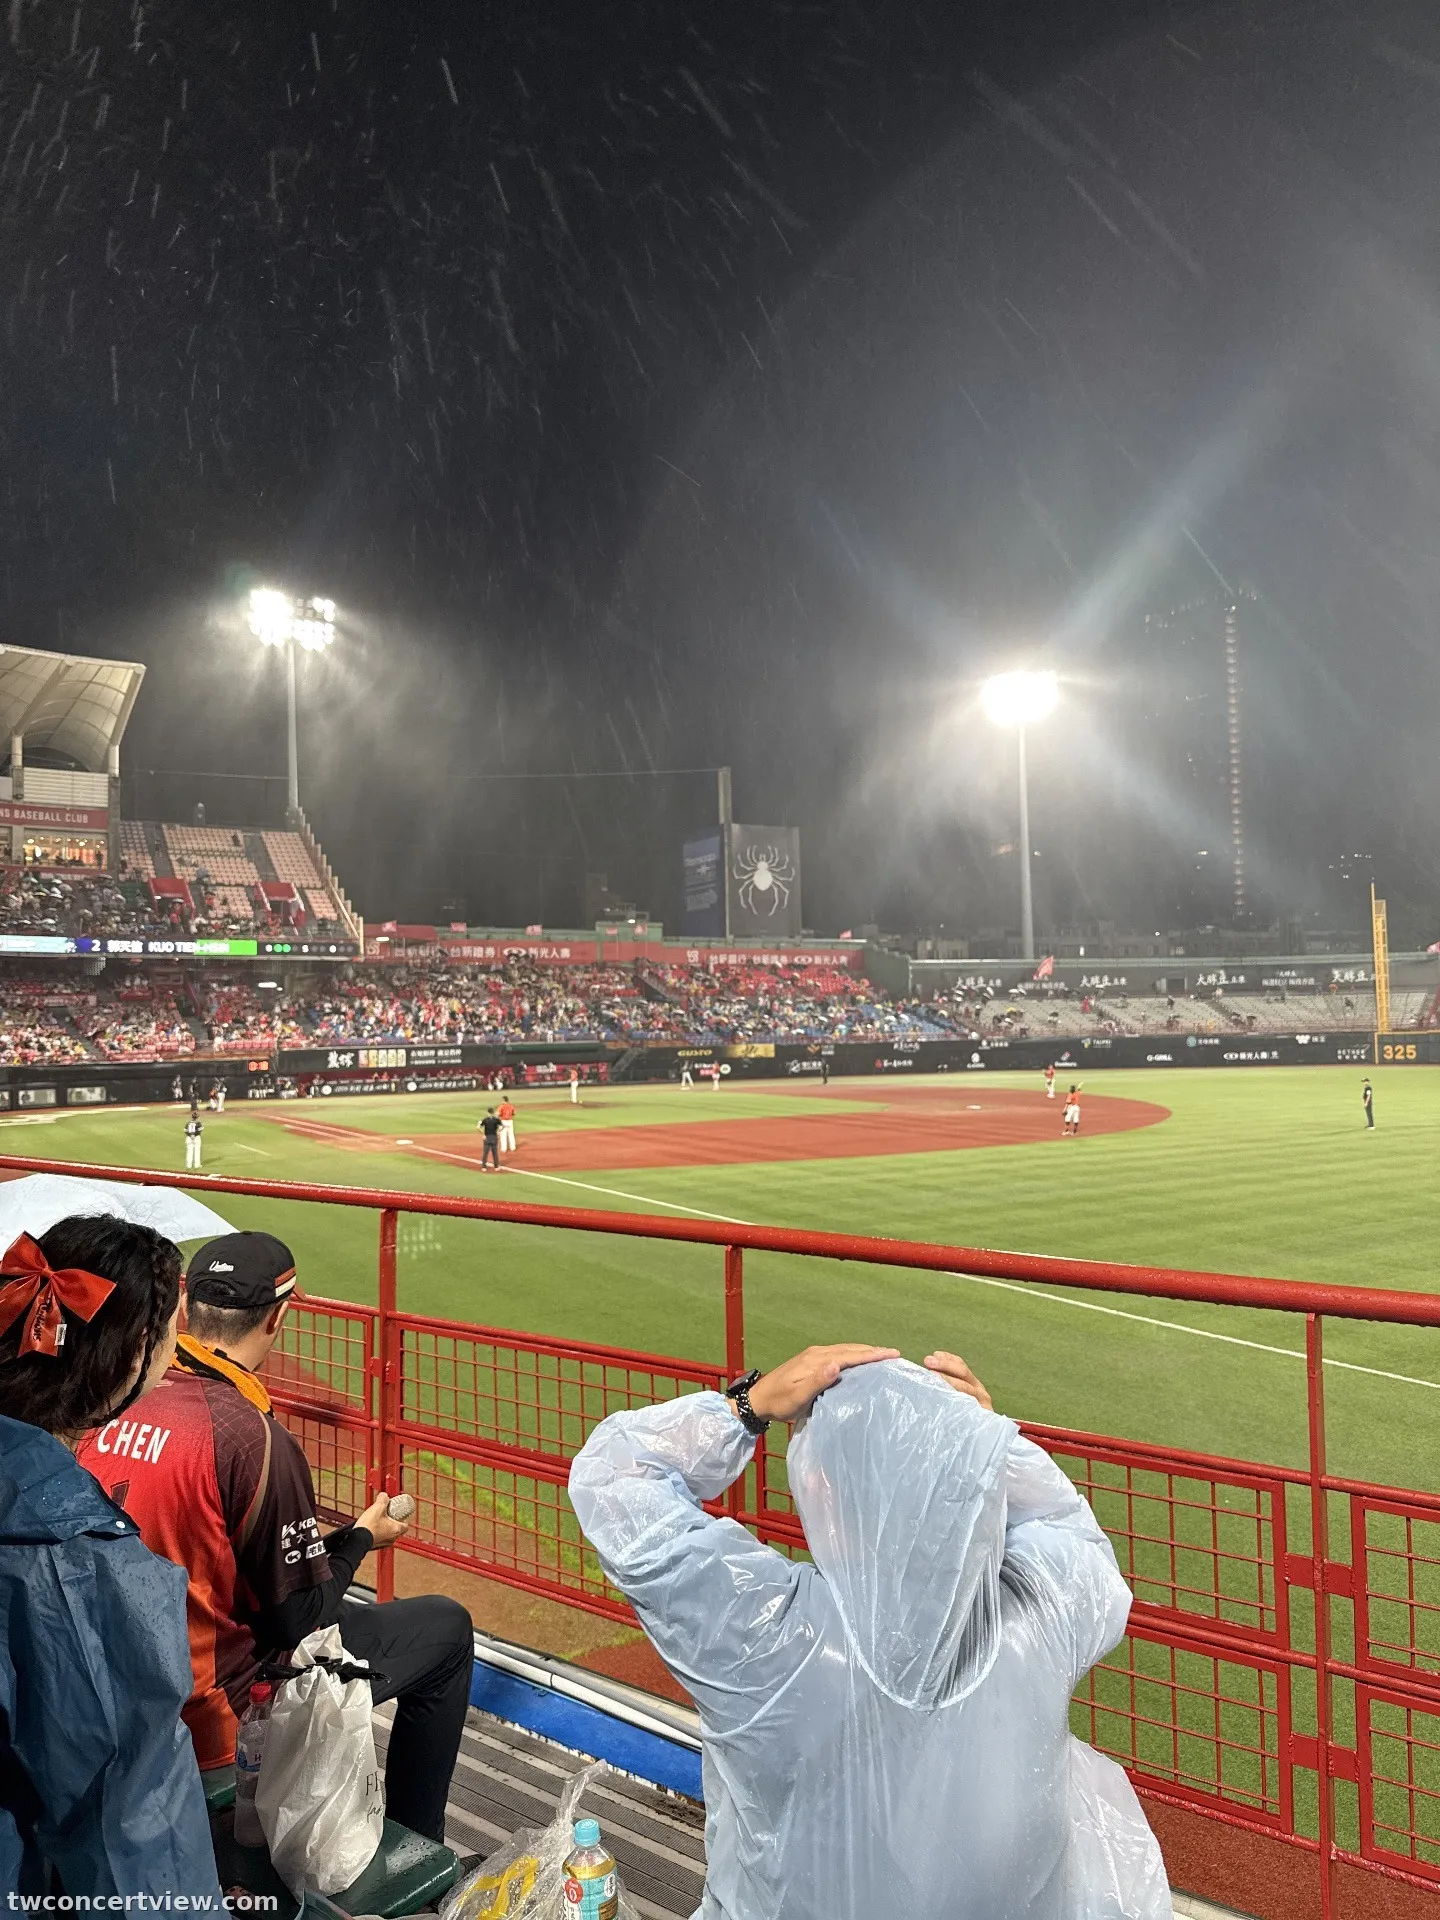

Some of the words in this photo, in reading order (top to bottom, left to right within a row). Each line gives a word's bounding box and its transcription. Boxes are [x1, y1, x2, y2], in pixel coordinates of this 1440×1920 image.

[14, 809, 61, 822] BASEBALL
[65, 813, 89, 824] CLUB
[91, 939, 101, 952] 2
[1383, 1044, 1416, 1060] 325
[97, 1419, 171, 1464] CHEN
